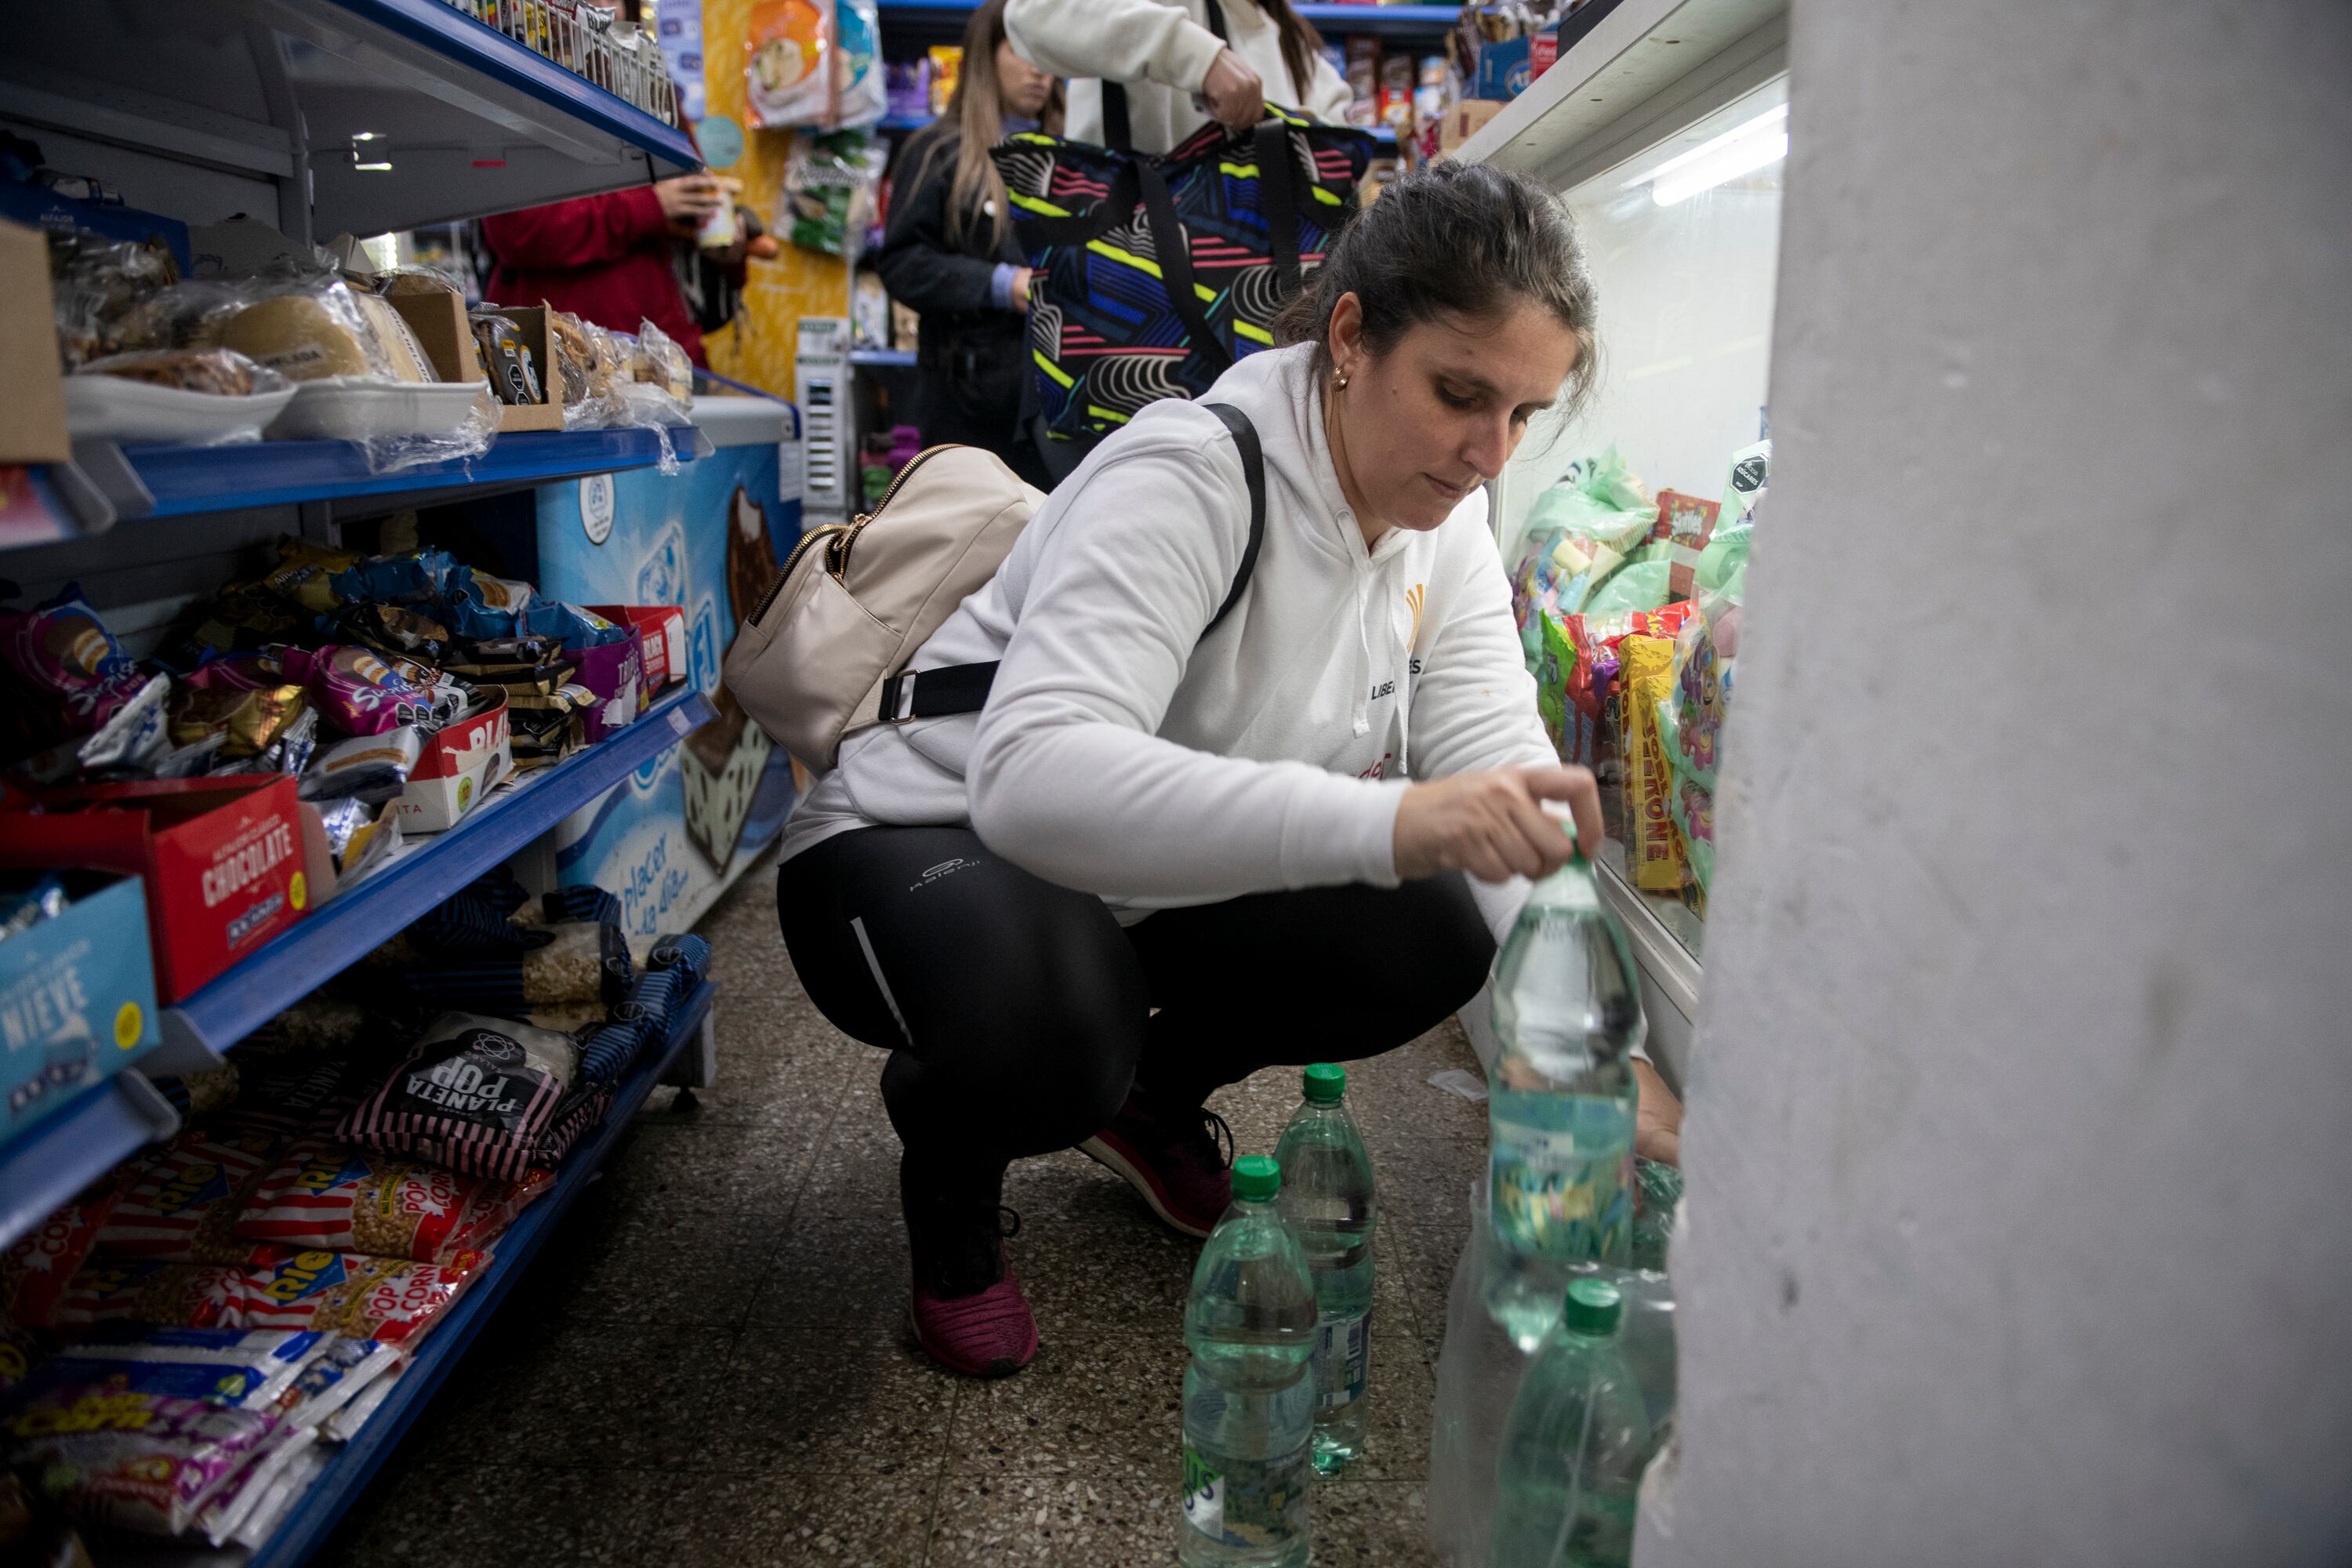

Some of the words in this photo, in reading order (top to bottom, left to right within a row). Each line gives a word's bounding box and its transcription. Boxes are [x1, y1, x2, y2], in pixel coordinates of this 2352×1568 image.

[202, 822, 293, 908] CHOCOLATE
[406, 1073, 517, 1112] PLANETA
[431, 1055, 510, 1098] POP
[405, 1181, 427, 1212] POP
[431, 1168, 452, 1207] CORN
[263, 1250, 335, 1301] RIO
[401, 1265, 437, 1312] CORN
[368, 1287, 399, 1317] POP
